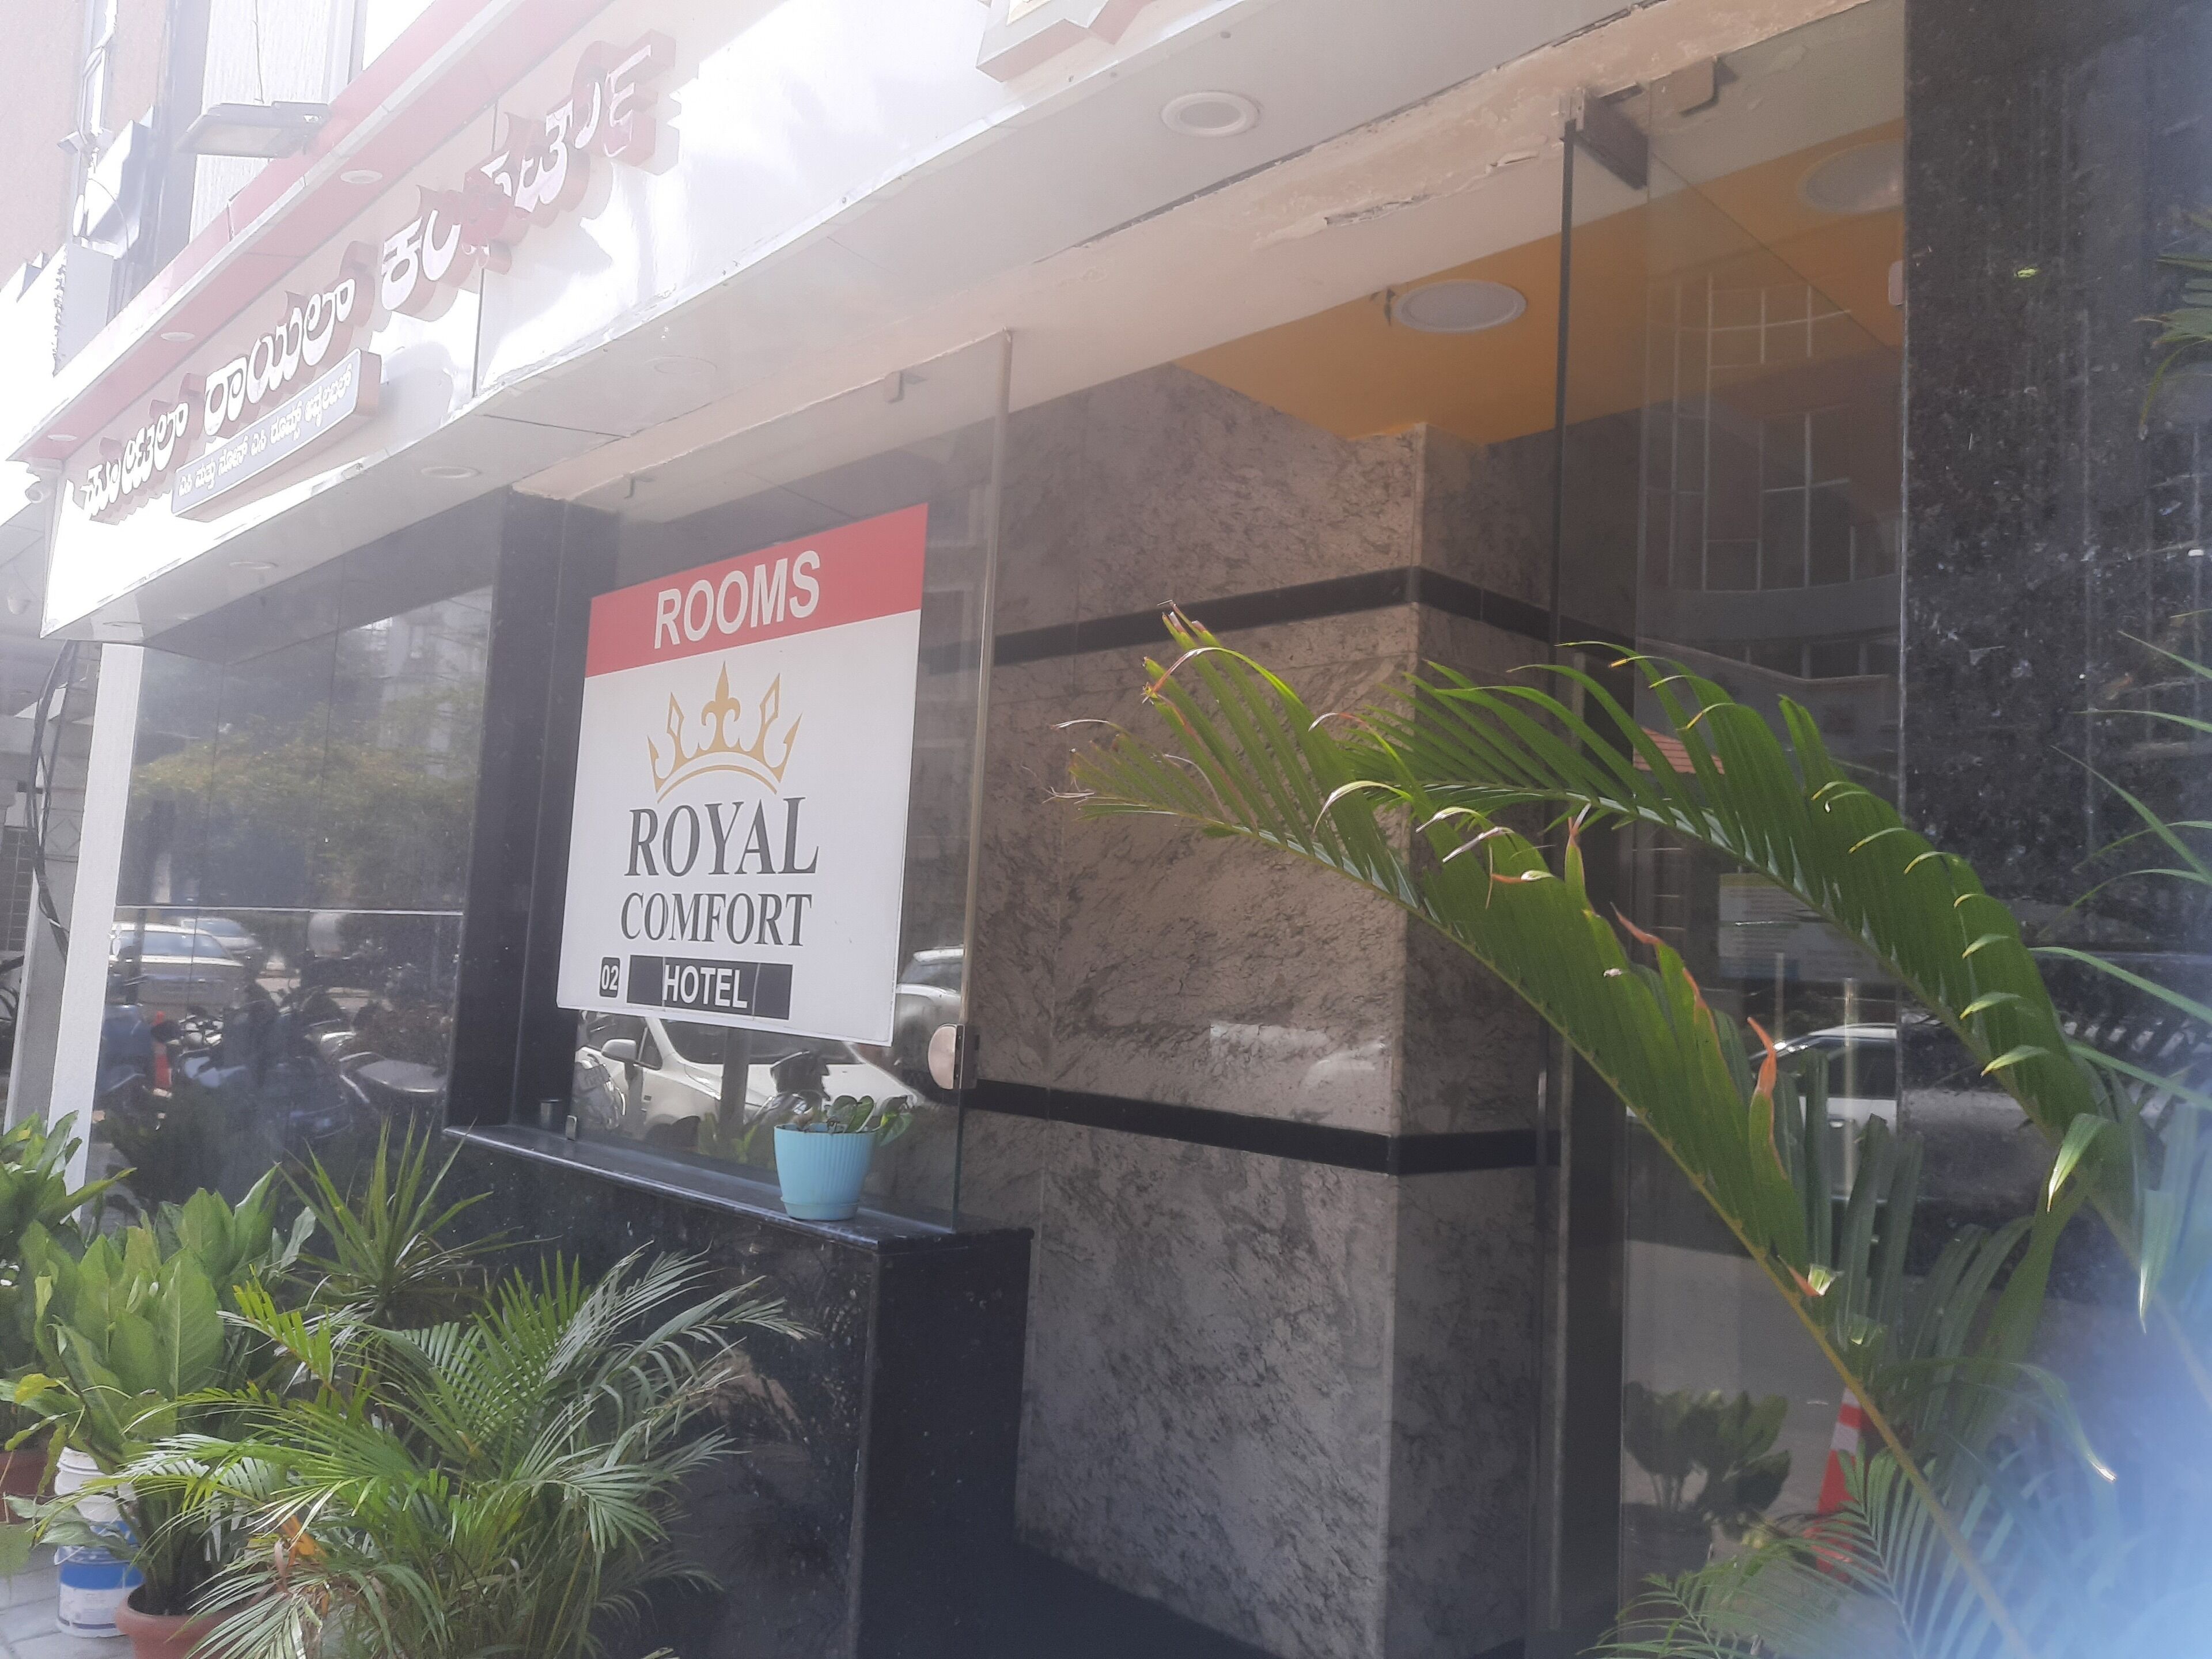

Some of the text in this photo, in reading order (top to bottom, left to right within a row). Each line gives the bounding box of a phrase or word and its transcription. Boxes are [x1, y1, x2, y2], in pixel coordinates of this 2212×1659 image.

[654, 550, 820, 650] ROOMS
[623, 796, 819, 878] ROYAL
[620, 891, 813, 948] COMFORT
[600, 963, 749, 1009] 02 HOTEL
